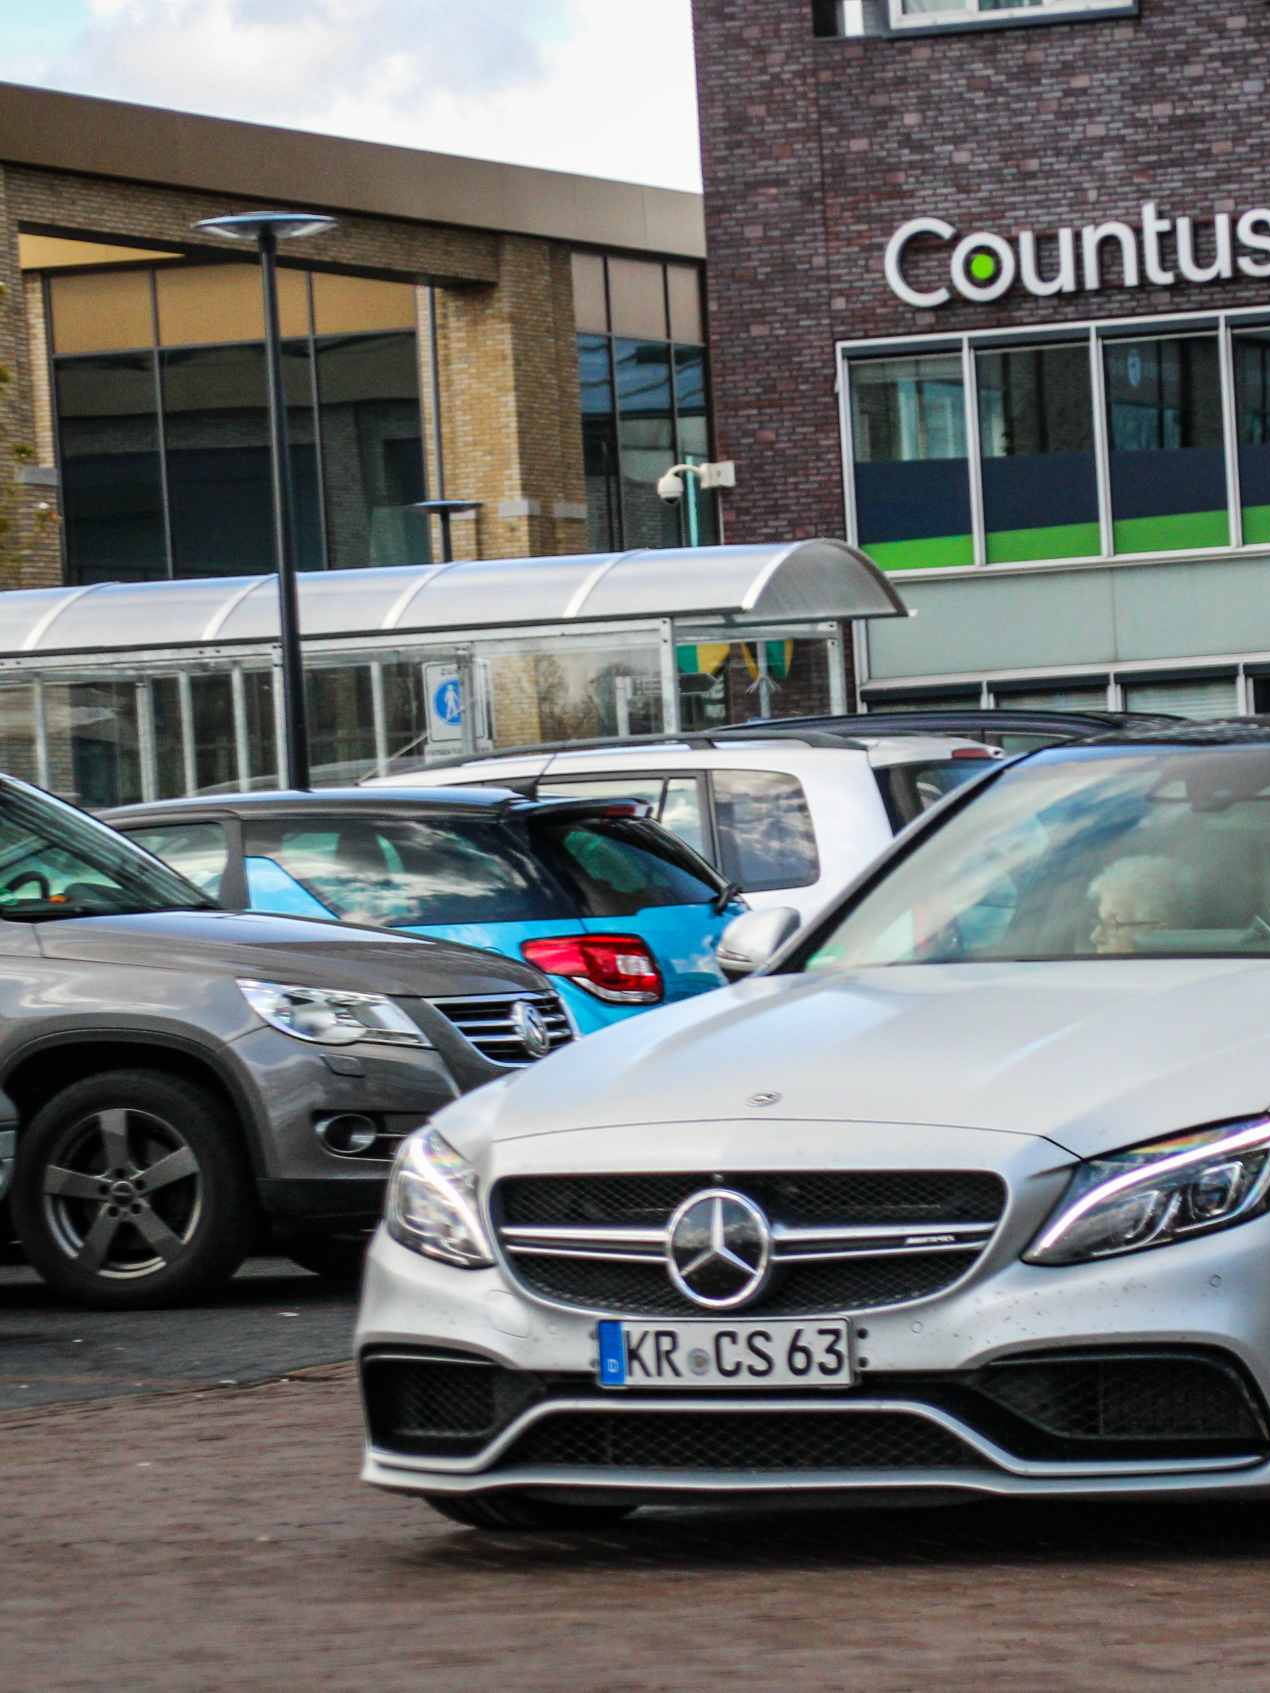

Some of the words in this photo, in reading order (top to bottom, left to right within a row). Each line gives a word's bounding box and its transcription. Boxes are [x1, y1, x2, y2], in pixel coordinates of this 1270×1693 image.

[625, 1329, 683, 1378] KR
[714, 1329, 775, 1378] CS
[787, 1328, 845, 1377] 63
